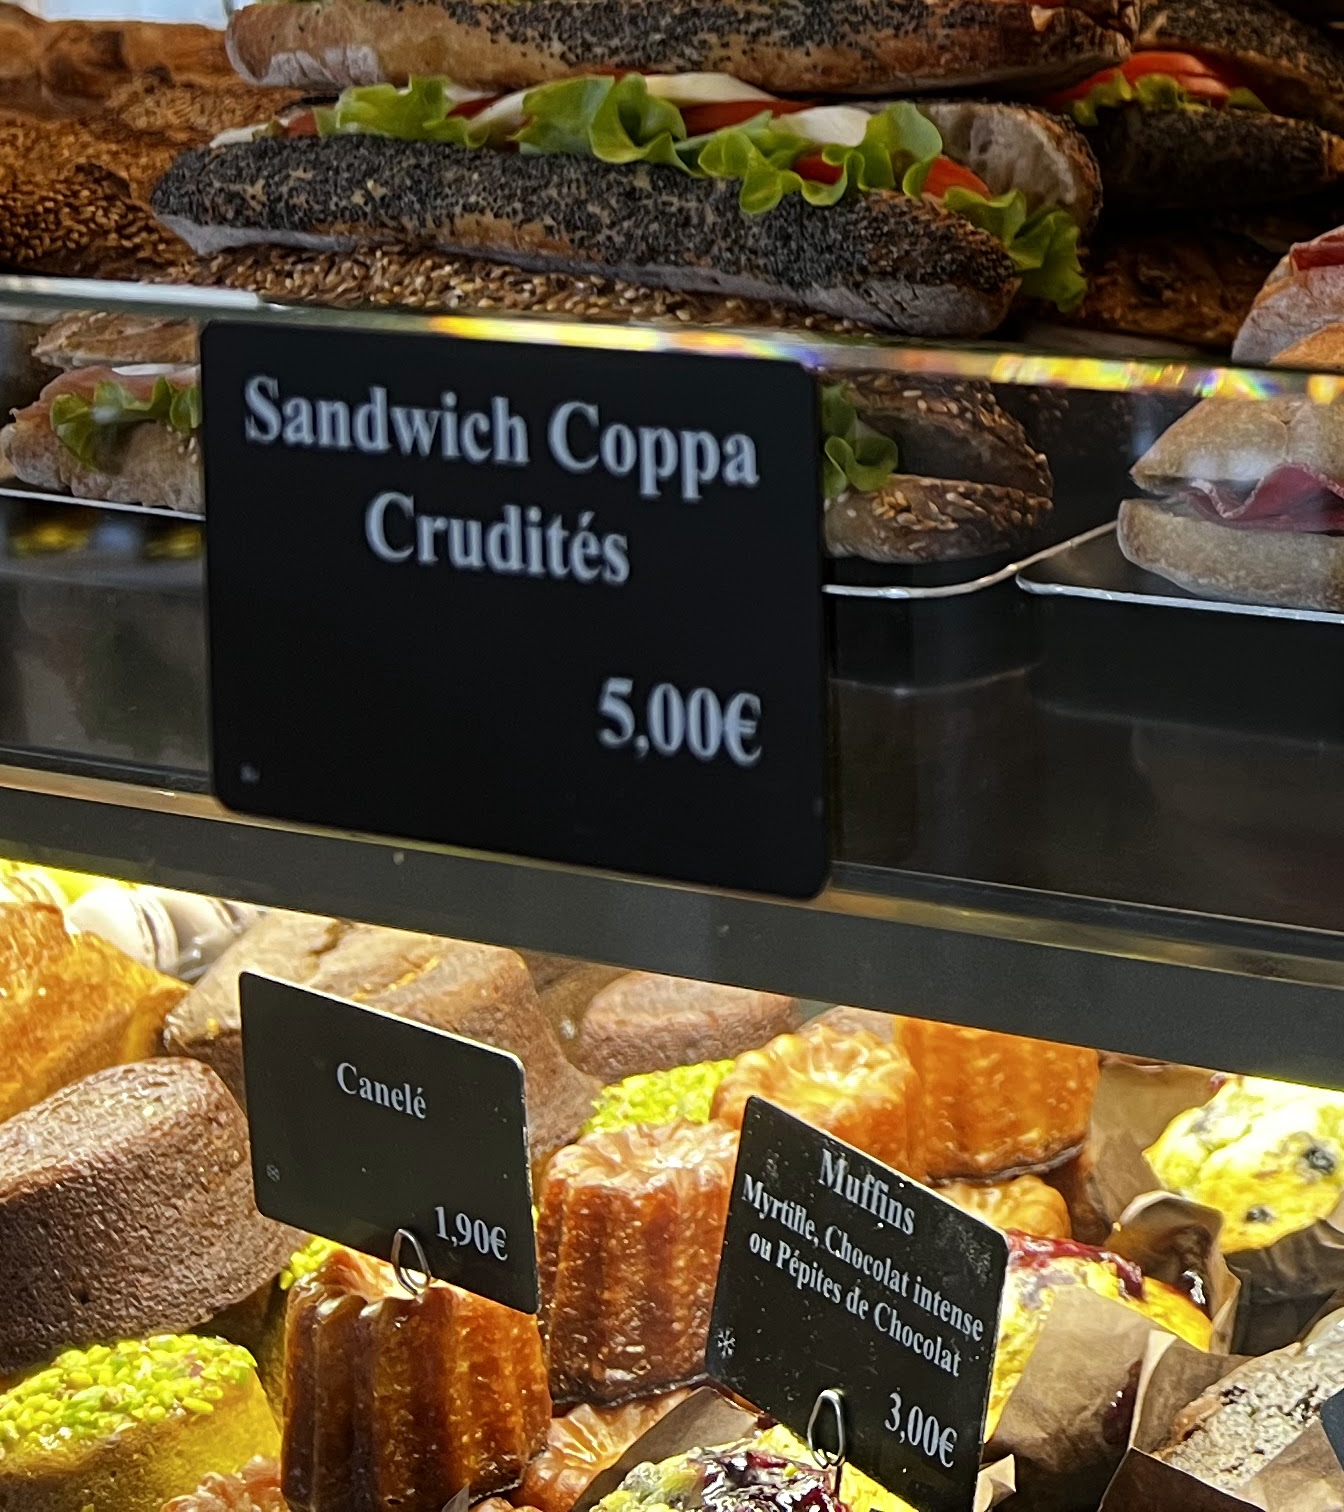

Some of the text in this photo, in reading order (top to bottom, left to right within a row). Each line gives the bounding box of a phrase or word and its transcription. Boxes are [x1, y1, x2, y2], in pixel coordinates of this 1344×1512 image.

[243, 374, 760, 501] Sandwich Coppa
[364, 490, 630, 586] Crudités
[598, 676, 763, 766] 5,00€
[335, 1060, 428, 1120] Canelé
[435, 1204, 510, 1262] 1,90€
[819, 1148, 915, 1236] Muffins
[741, 1174, 984, 1342] Myrtille, Chocolat intense
[749, 1230, 962, 1378] ou Pépites de Chocolat
[884, 1392, 958, 1469] 3,00€
